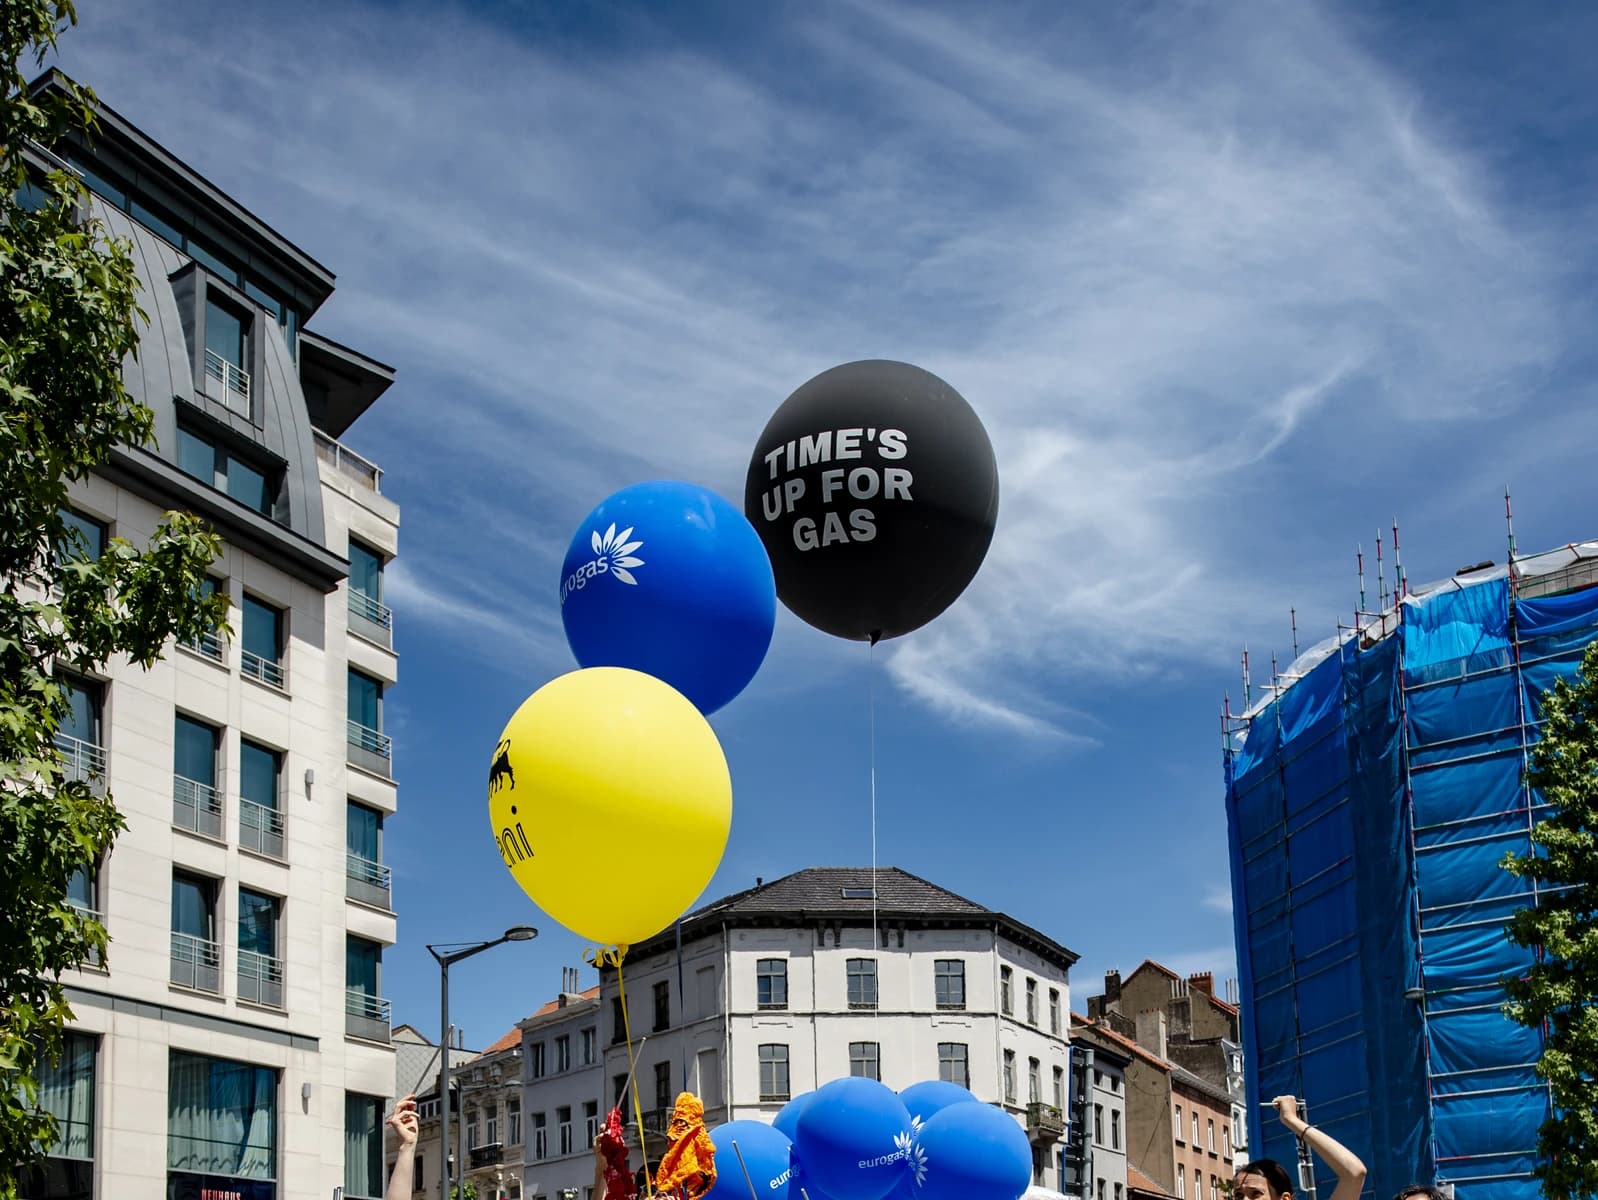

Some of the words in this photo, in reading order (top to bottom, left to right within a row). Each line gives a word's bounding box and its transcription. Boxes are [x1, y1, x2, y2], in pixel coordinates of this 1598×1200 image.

[764, 428, 908, 480] TIME'S
[762, 478, 806, 521] UP
[822, 467, 914, 503] FOR
[793, 508, 877, 551] GAS
[560, 556, 609, 605] urogas
[858, 1149, 905, 1169] eurogas
